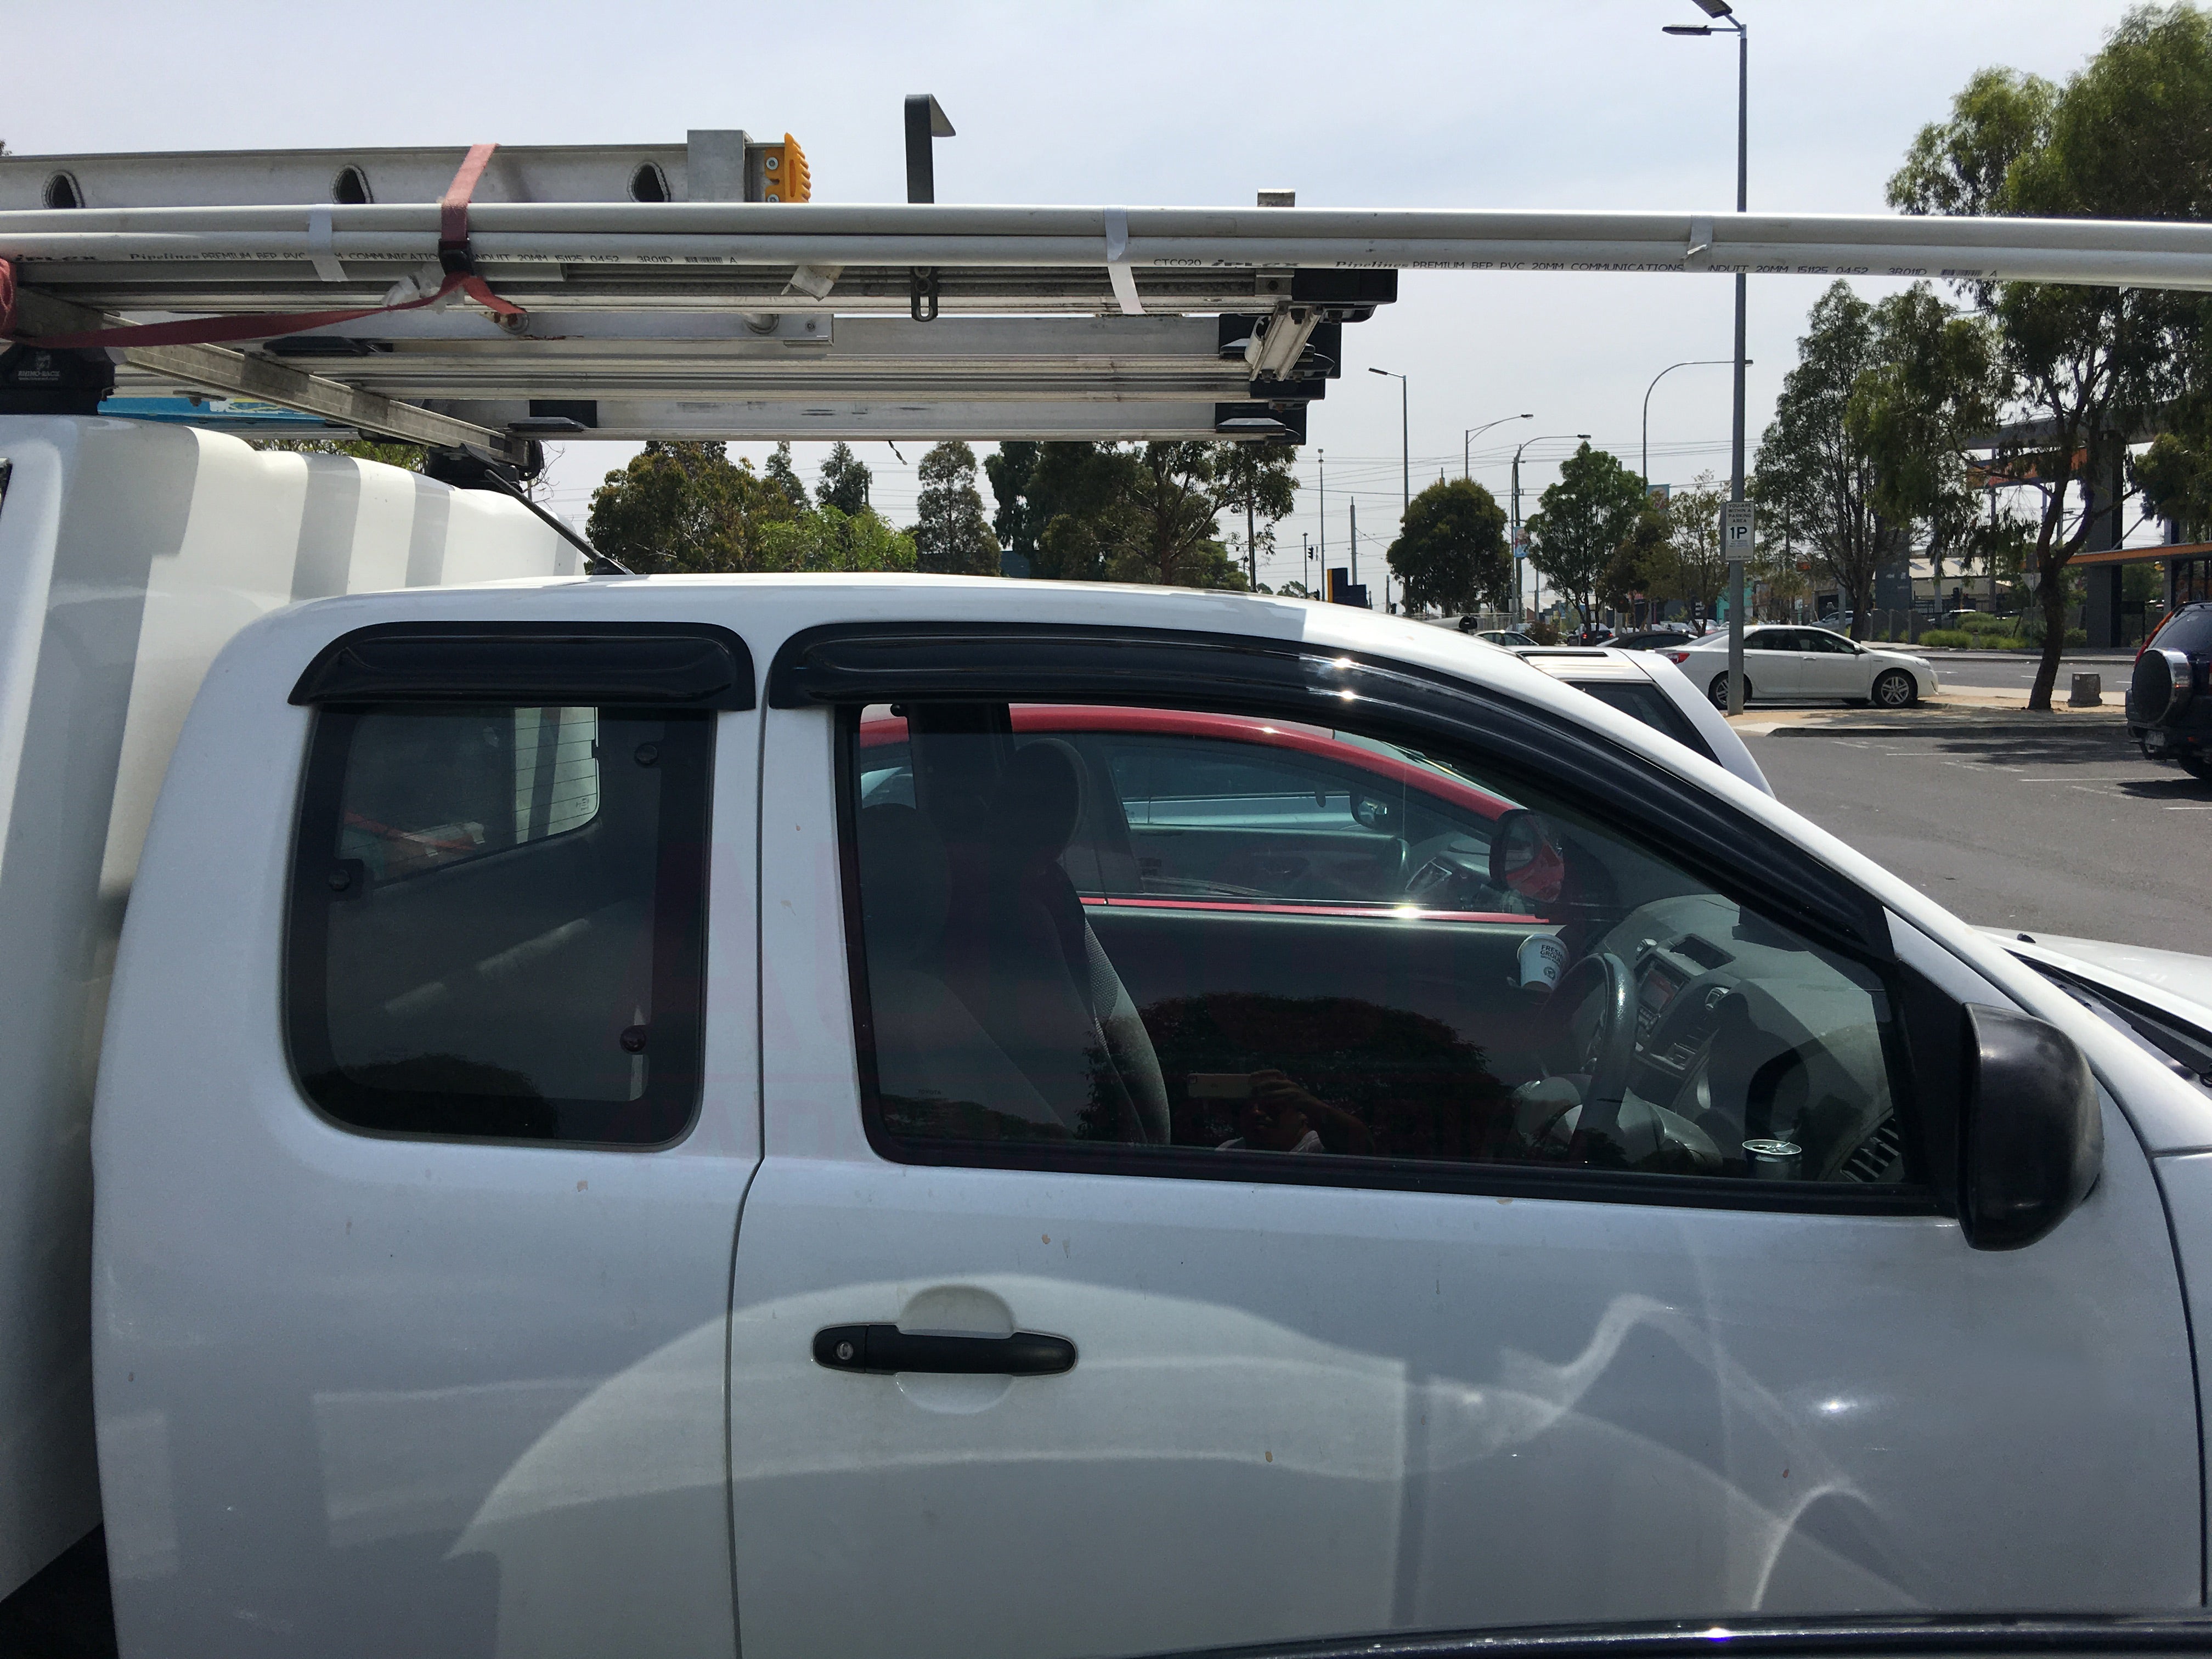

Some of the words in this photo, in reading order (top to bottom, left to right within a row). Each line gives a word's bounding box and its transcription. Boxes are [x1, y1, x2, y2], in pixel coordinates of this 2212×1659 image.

[1413, 261, 1465, 269] PREMIUM
[1531, 262, 1564, 270] 20MM
[1571, 263, 1684, 272] COMMUNICATIONS
[1730, 527, 1747, 539] 1P
